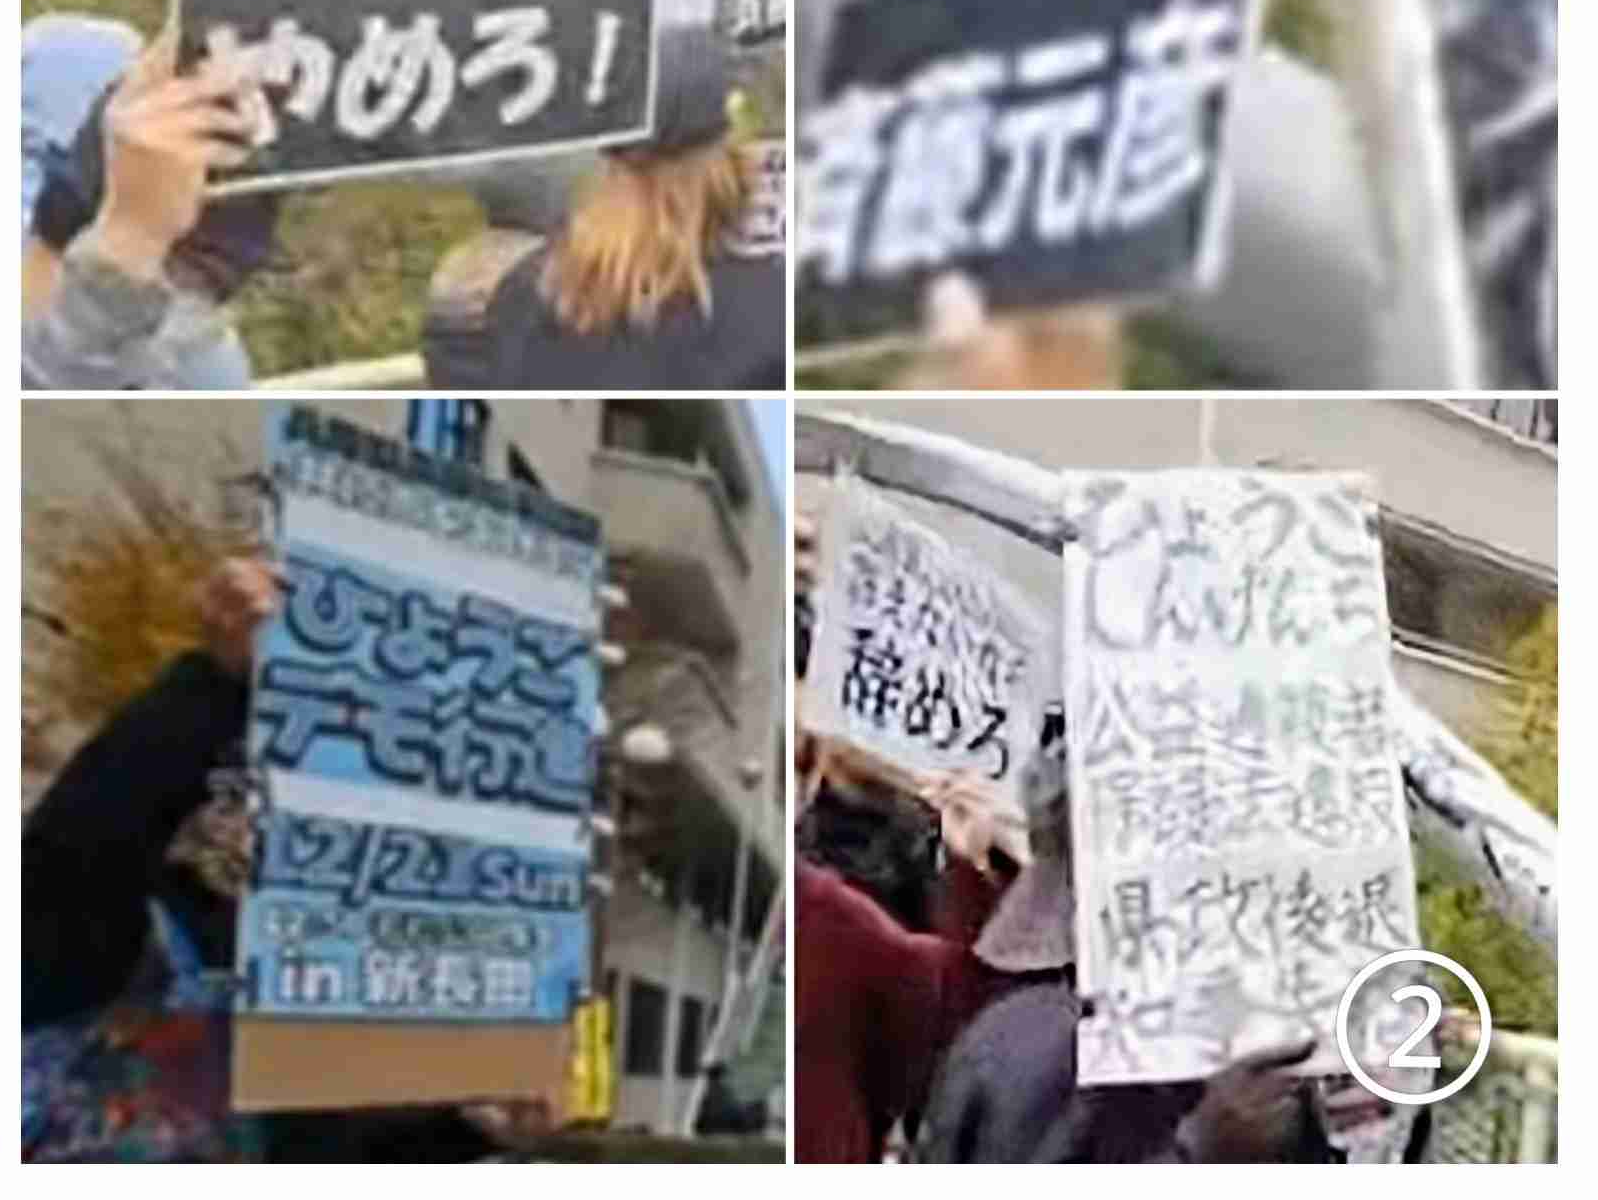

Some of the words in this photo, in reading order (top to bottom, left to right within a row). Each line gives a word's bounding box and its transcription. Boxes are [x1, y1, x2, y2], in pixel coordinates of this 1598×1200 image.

[842, 627, 1010, 780] 辞めろ
[279, 957, 343, 1003] in
